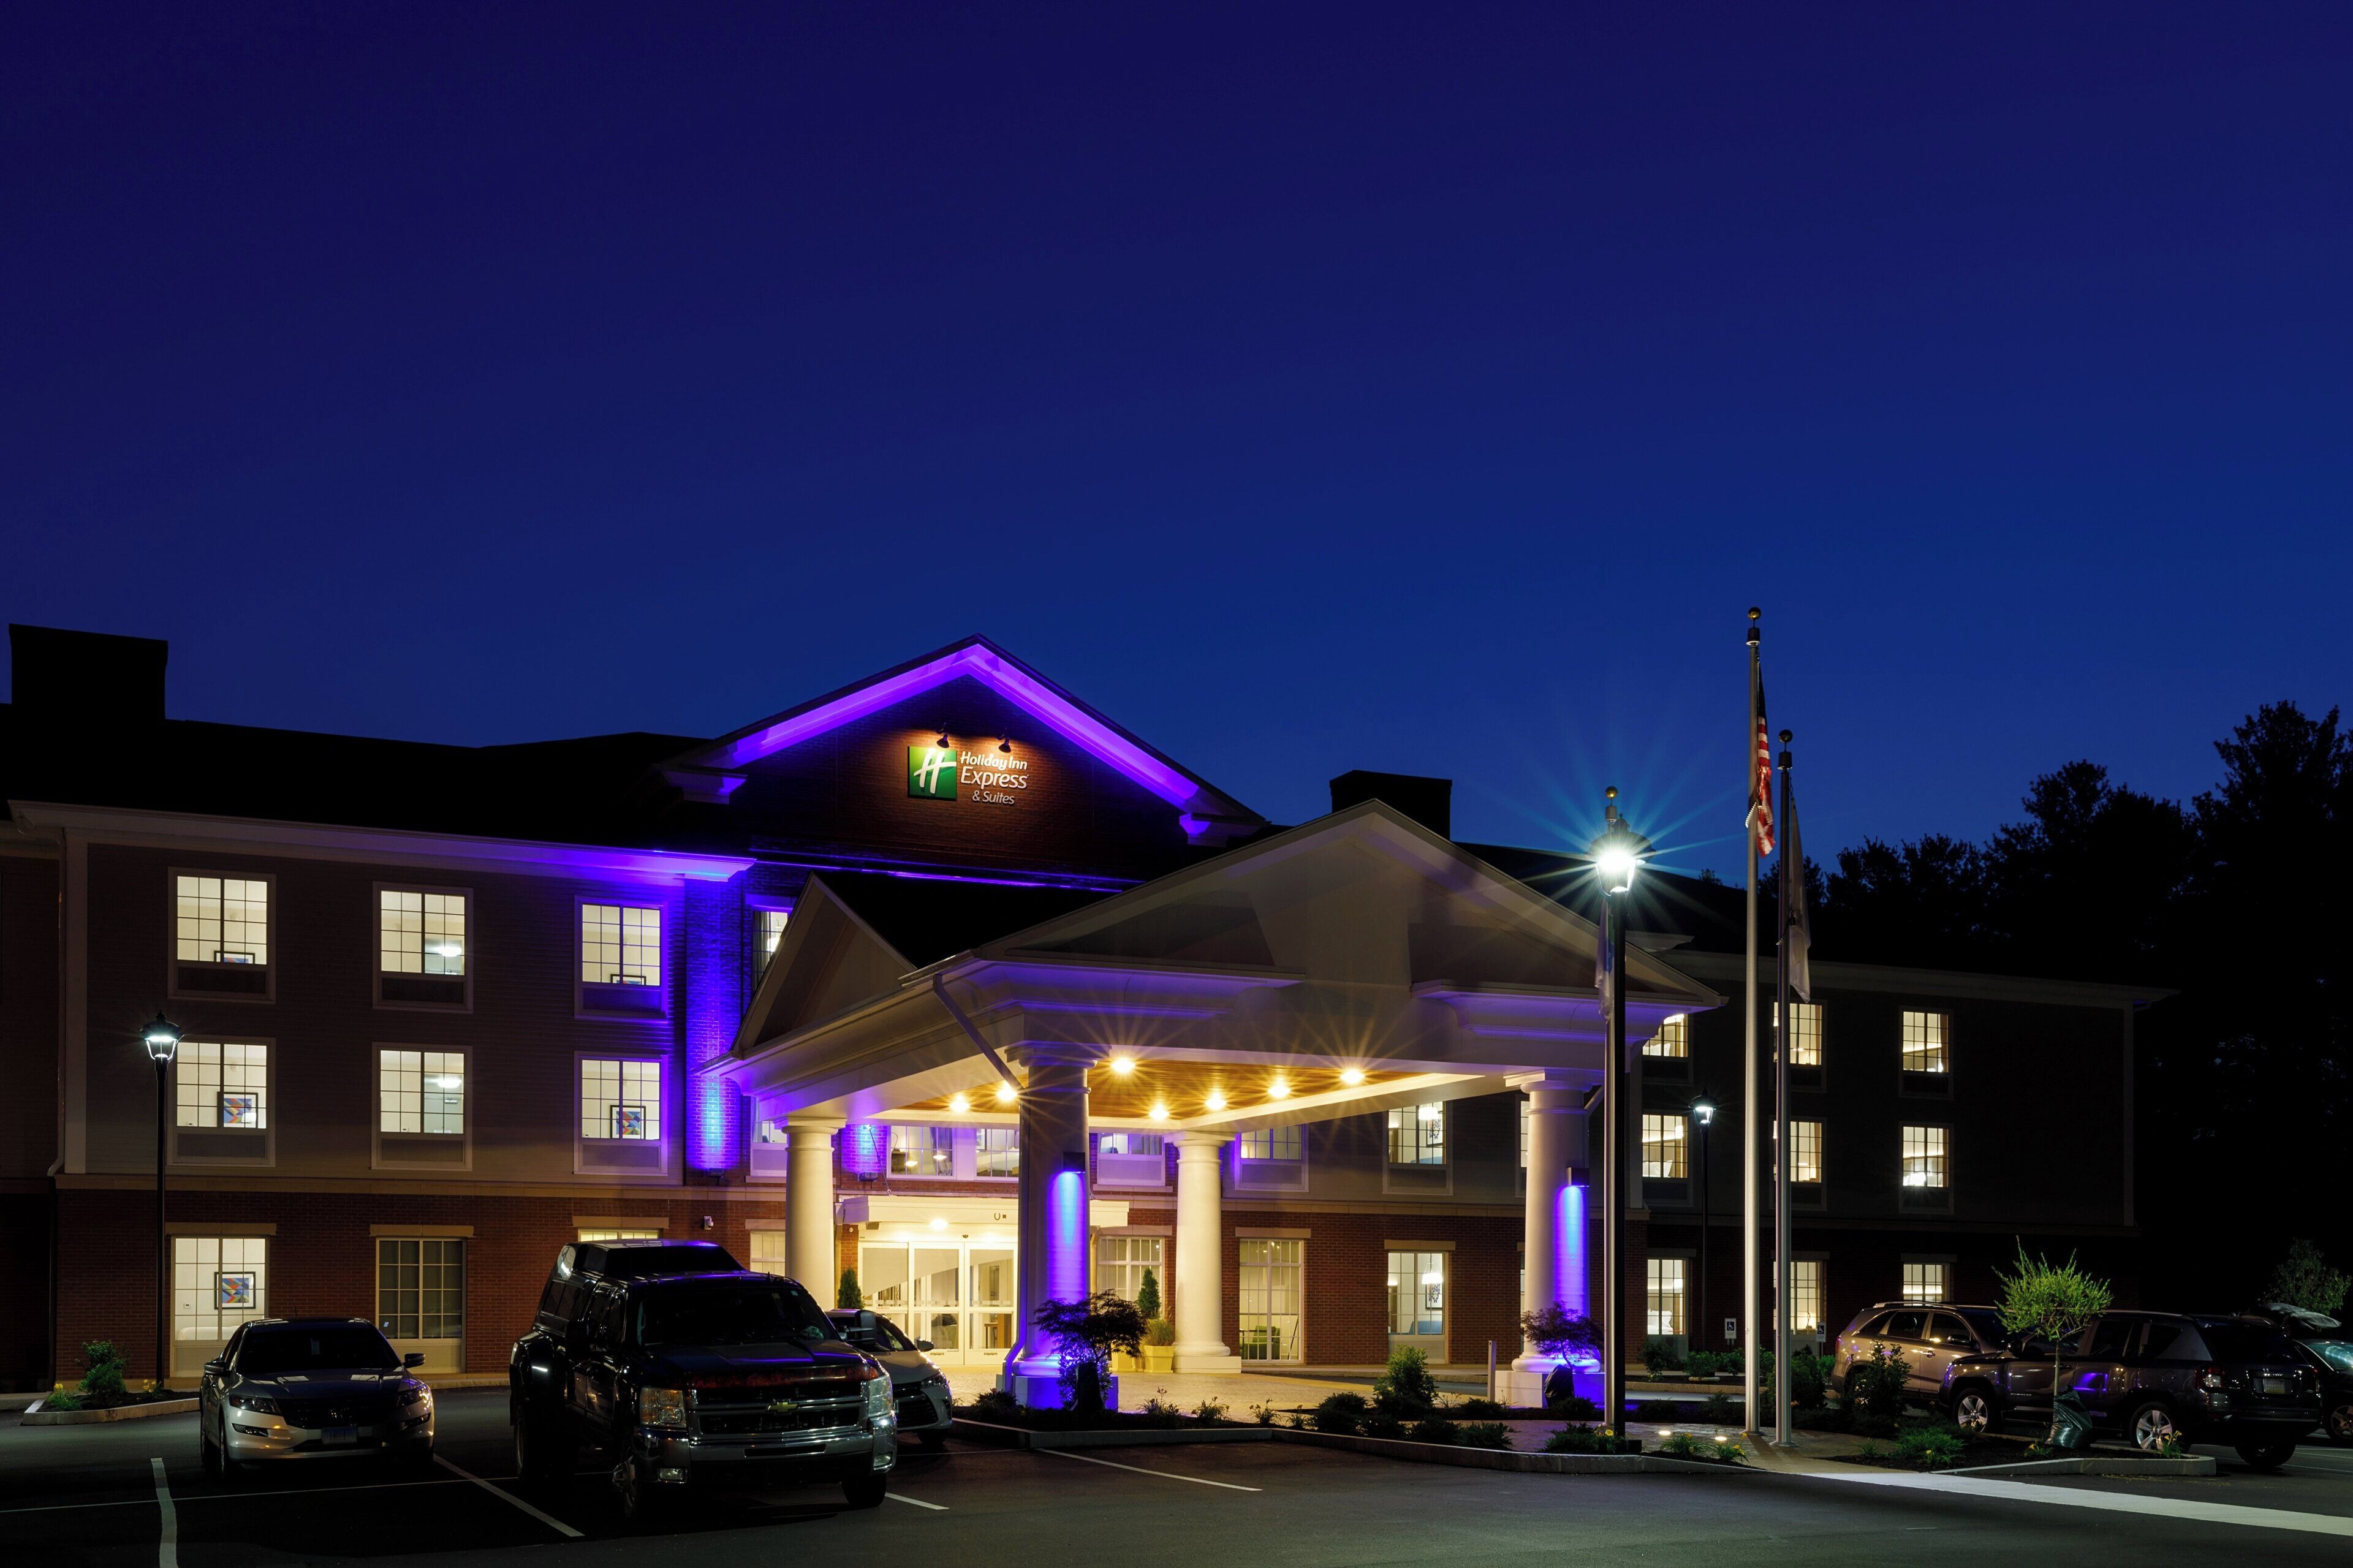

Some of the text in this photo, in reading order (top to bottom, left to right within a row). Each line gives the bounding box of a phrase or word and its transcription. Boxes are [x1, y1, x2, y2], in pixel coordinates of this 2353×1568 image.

[960, 751, 1027, 770] Holiday Inn
[961, 766, 1028, 790] Express
[972, 790, 1015, 804] & Suites
